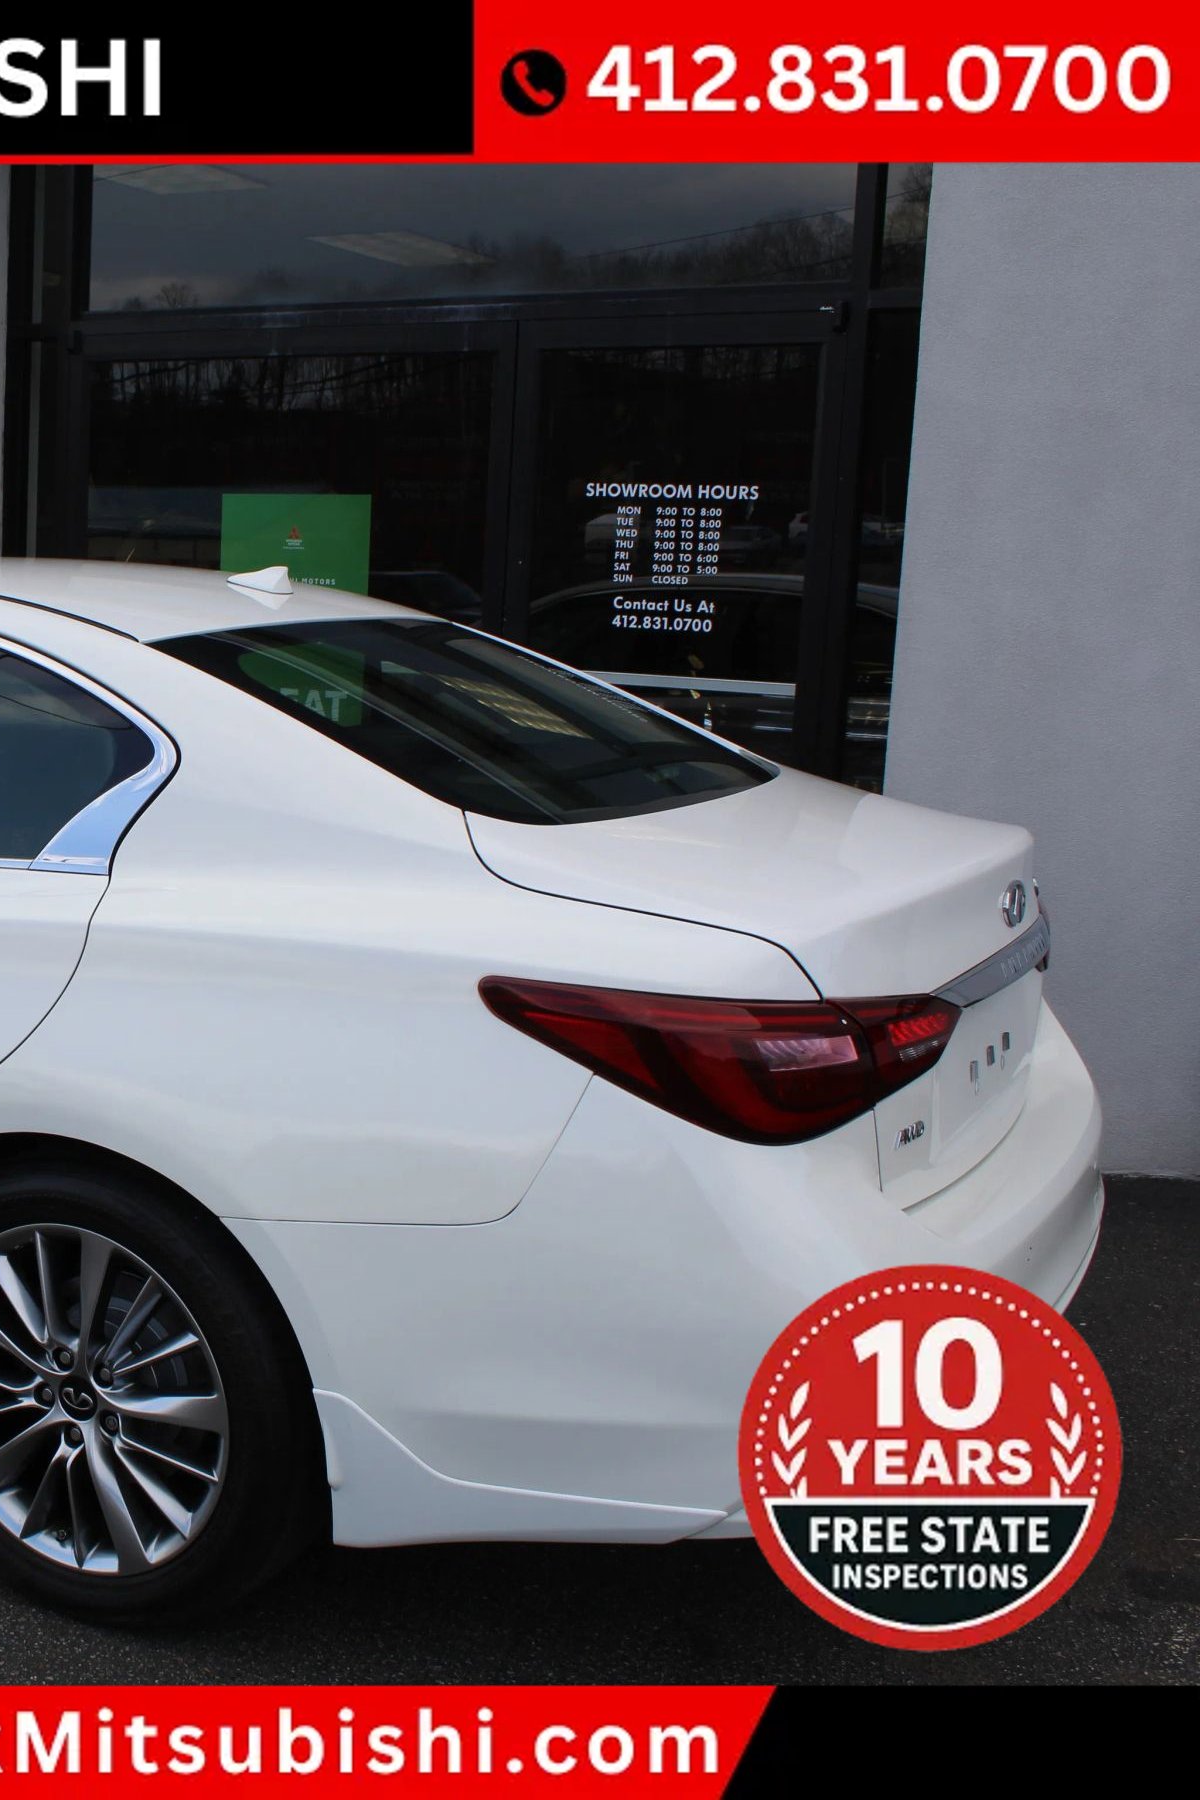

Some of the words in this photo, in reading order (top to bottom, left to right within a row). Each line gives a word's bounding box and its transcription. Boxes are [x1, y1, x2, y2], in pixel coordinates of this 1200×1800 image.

[586, 483, 692, 498] SHOWROOM
[698, 485, 759, 500] HOURS
[617, 506, 641, 515] MON
[656, 507, 677, 516] 9:00
[682, 507, 695, 515] TO
[700, 508, 722, 517] 8:00
[616, 517, 634, 526] TUE
[655, 518, 676, 527] 9:00
[681, 519, 694, 527] TO
[699, 519, 721, 528] 8:00
[616, 529, 638, 537] WED
[655, 529, 676, 539] 9:00
[681, 530, 694, 539] TO
[698, 531, 720, 540] 8:00
[615, 540, 634, 549] THU
[654, 541, 675, 550] 9:00
[680, 542, 693, 551] TO
[697, 542, 720, 552] 8:00
[614, 551, 629, 560] FRI
[653, 552, 674, 561] 9:00
[679, 553, 692, 562] TO
[696, 554, 718, 563] 6:00
[613, 563, 631, 572] SAT
[652, 564, 673, 573] 9:00
[677, 564, 690, 573] TO
[696, 566, 718, 575] 5:00
[301, 577, 336, 586] MOTORS
[613, 574, 633, 583] SUN
[651, 576, 689, 585] CLOSED
[613, 596, 669, 611] Contact
[674, 599, 692, 613] Us
[696, 600, 715, 614] At
[612, 615, 712, 633] 412.831.0700
